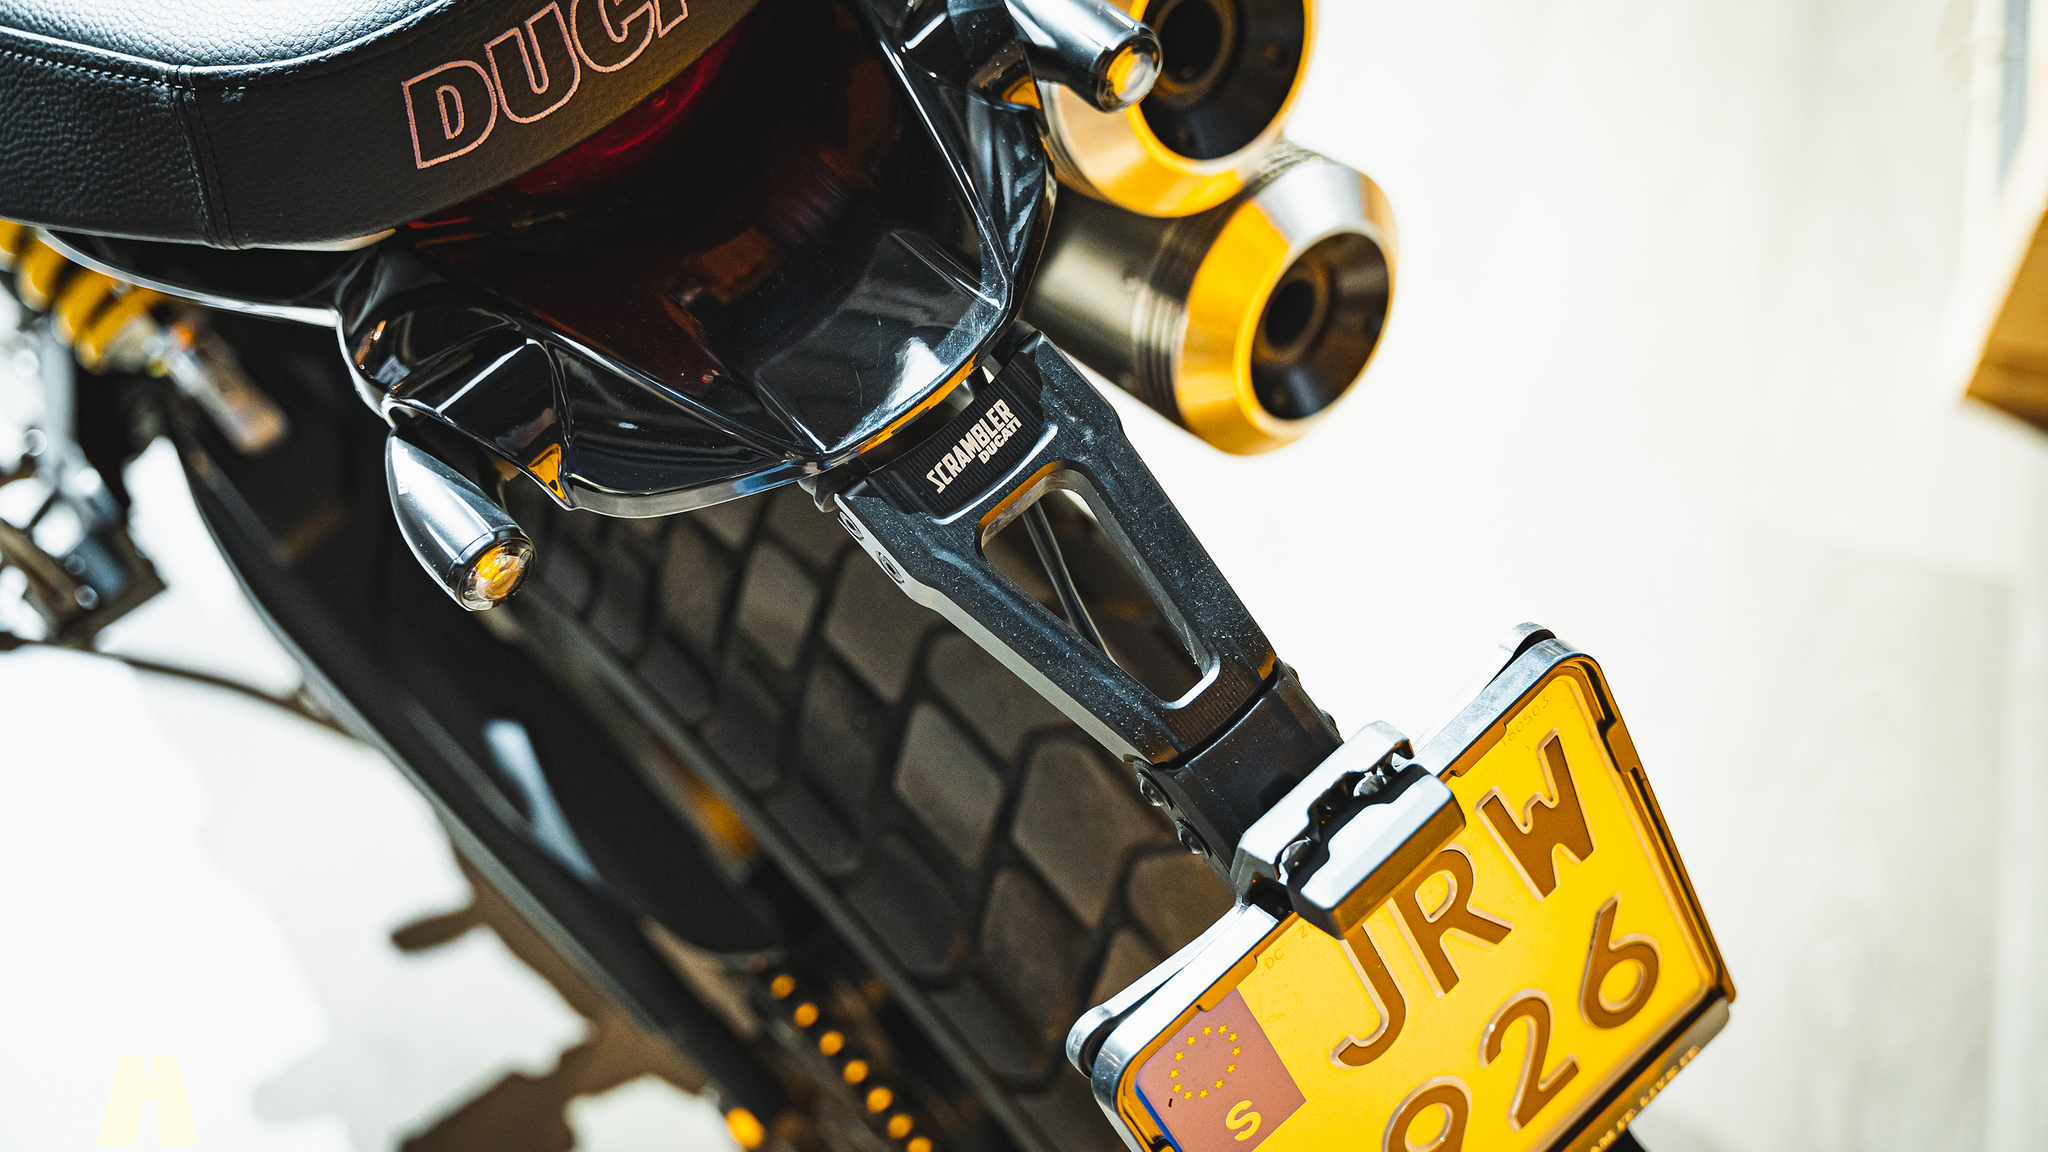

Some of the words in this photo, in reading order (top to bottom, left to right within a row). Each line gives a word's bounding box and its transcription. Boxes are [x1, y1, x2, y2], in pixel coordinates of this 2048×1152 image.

[926, 398, 1015, 494] SCRAMBLER
[978, 417, 1022, 464] DUCATI
[1329, 727, 1597, 1070] JRW
[1225, 1100, 1262, 1141] S
